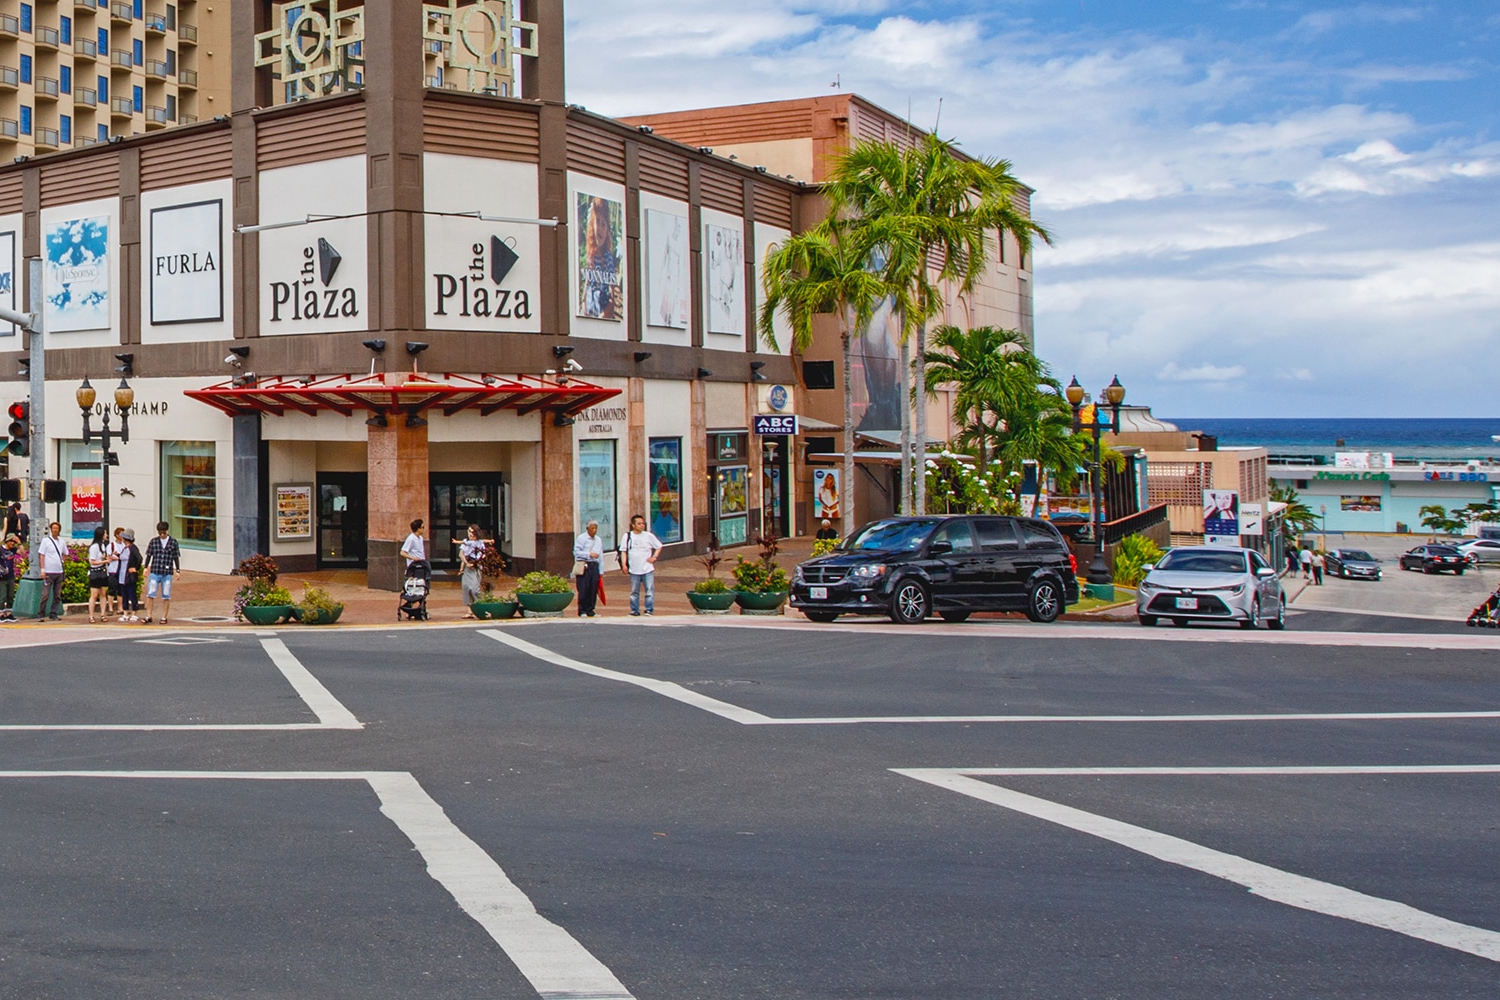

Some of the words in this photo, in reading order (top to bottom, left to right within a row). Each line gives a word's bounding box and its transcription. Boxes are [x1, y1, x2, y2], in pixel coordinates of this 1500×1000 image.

[156, 251, 216, 276] FURLA
[301, 246, 315, 286] the
[469, 243, 484, 282] the
[270, 280, 359, 322] Plaza
[433, 274, 532, 320] Plaza
[591, 408, 626, 421] DIAMONDS
[589, 424, 612, 433] AUSTRALIA
[757, 417, 793, 427] ABC
[1459, 472, 1488, 482] BBQ
[76, 487, 97, 498] Paul
[73, 502, 101, 512] Smith
